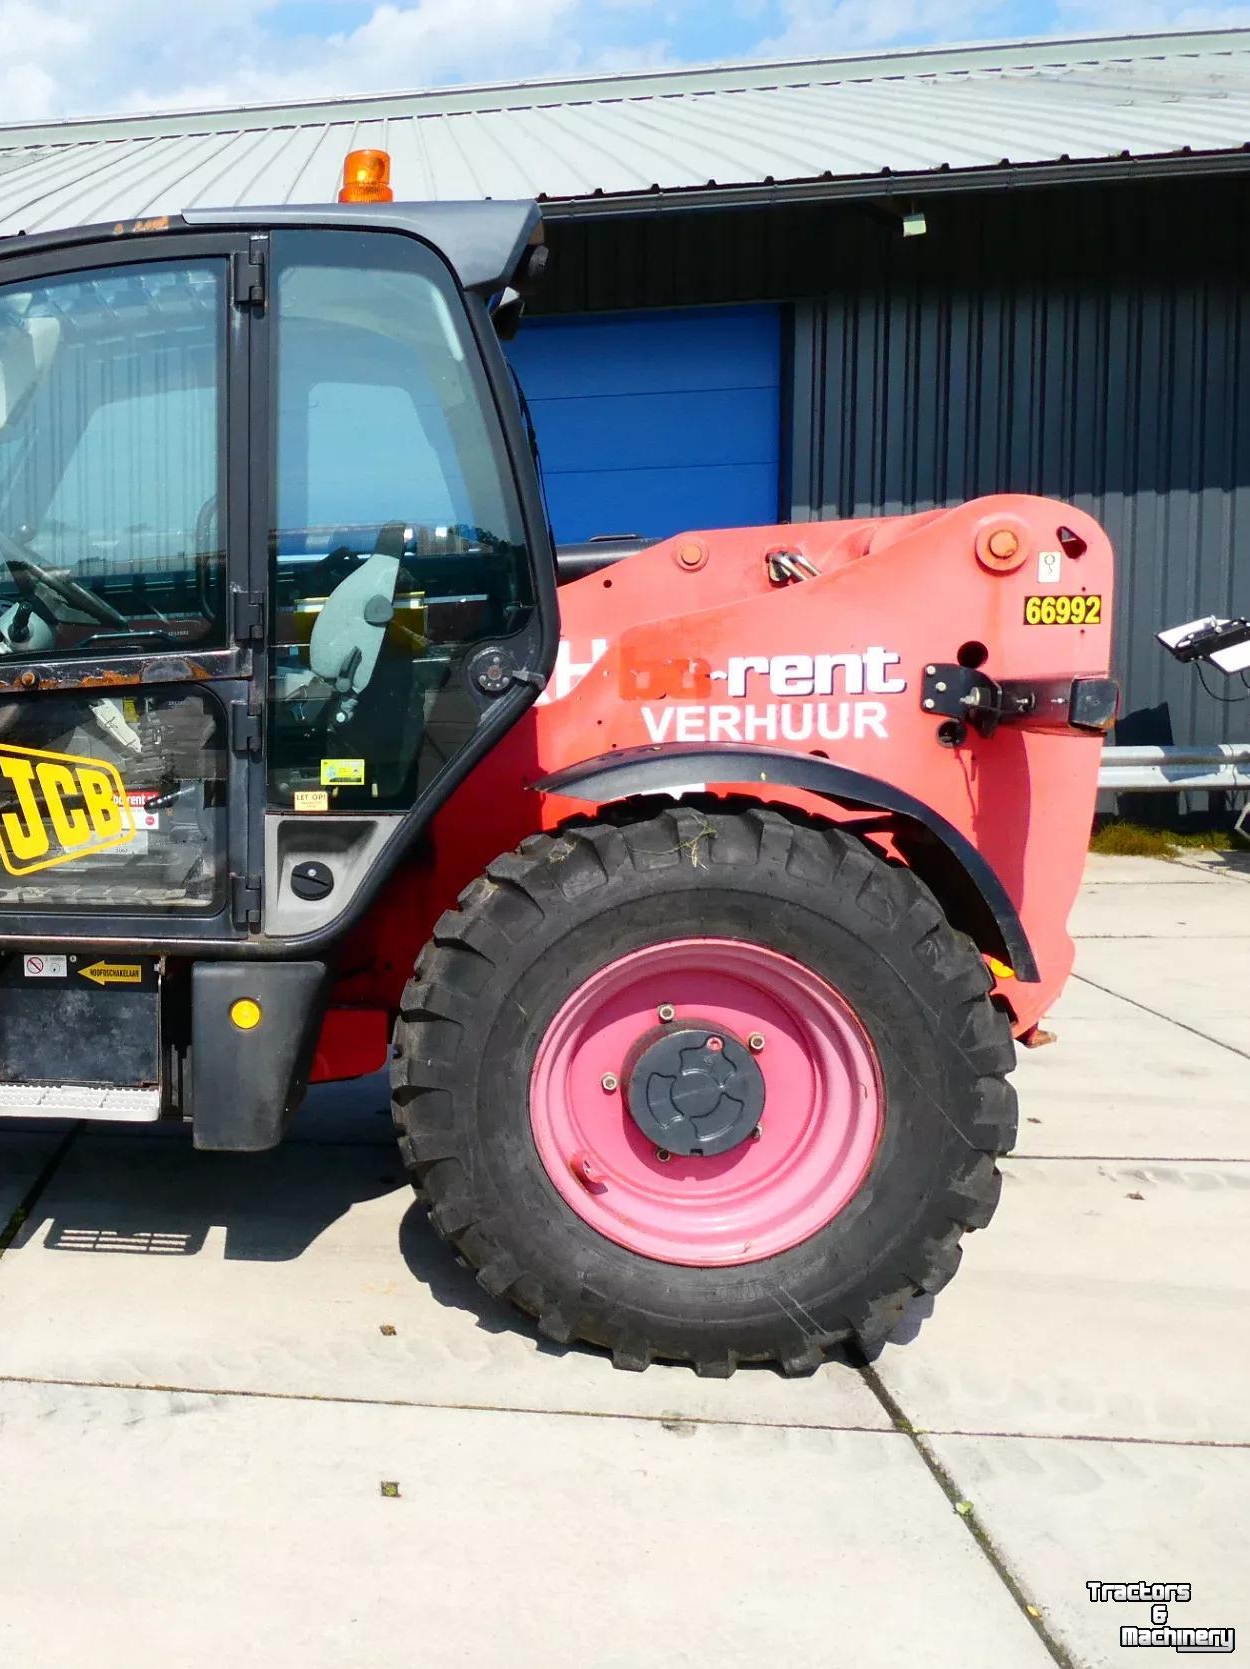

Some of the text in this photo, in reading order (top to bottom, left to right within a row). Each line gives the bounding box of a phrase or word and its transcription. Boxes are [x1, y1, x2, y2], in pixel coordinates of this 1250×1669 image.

[1026, 595, 1101, 624] 66992
[641, 701, 889, 742] VERHUUR
[296, 793, 326, 801] LET OP!
[89, 968, 139, 977] HOOFDSCHAKELAAR
